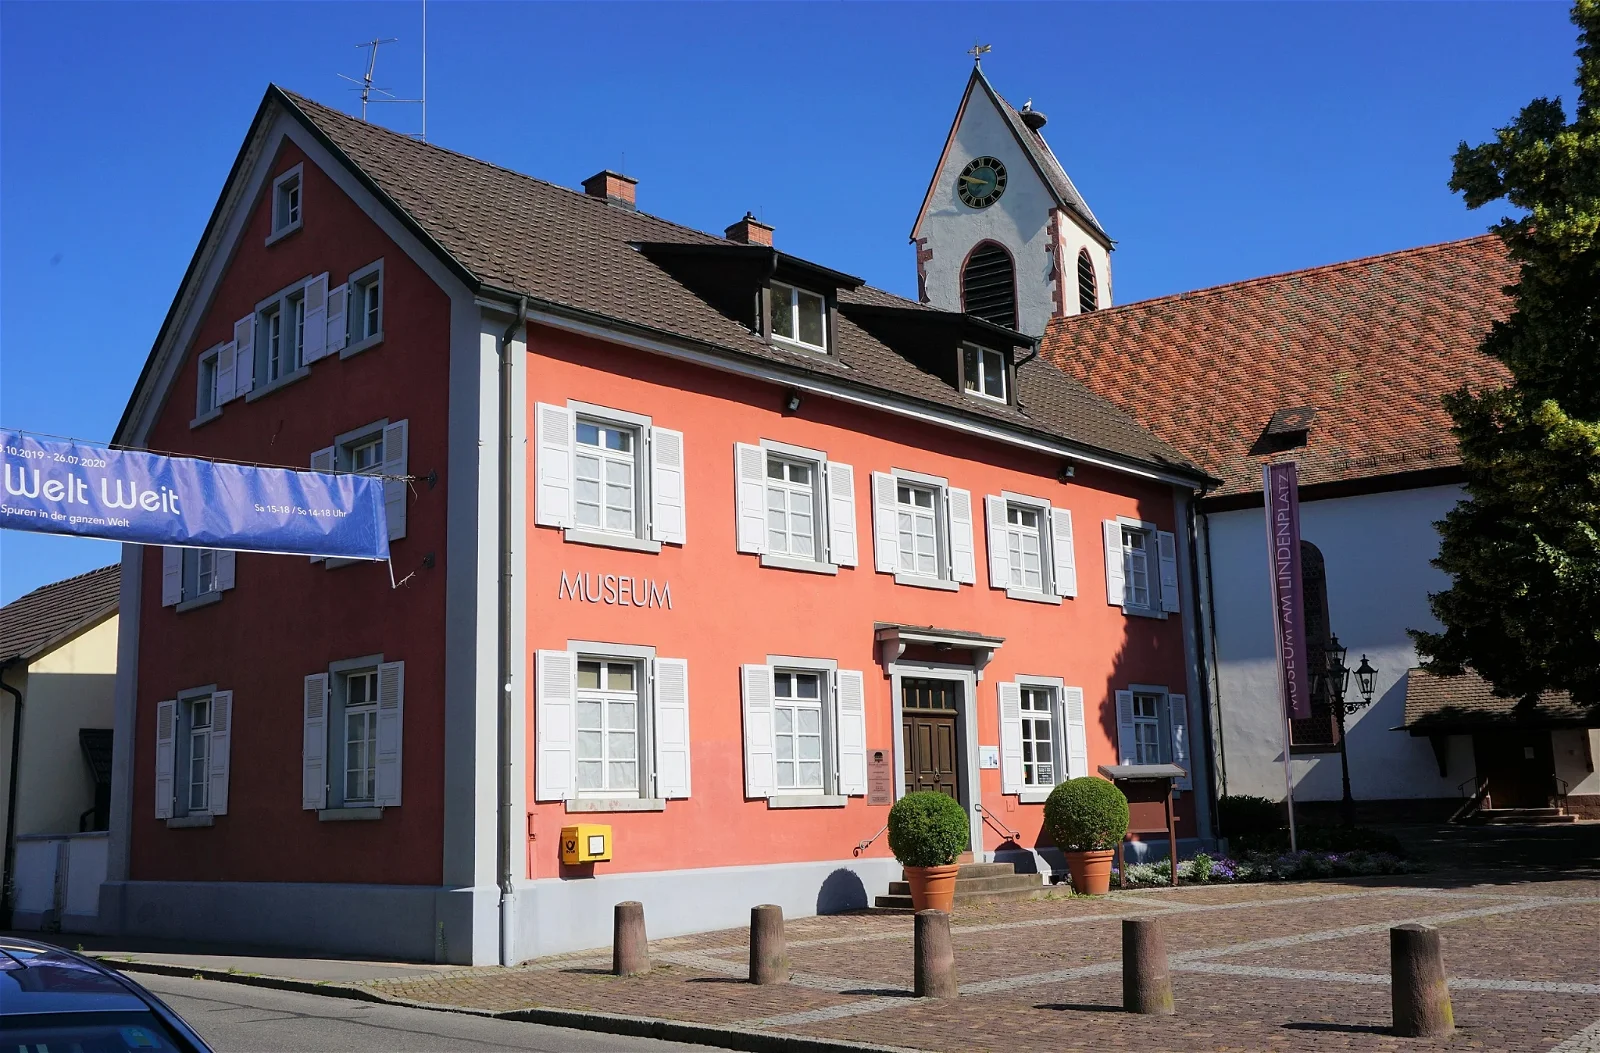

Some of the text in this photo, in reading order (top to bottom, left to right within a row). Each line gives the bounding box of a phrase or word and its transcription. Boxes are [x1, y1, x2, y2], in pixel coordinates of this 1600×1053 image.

[53, 452, 106, 468] 26.07.2020
[5, 463, 180, 515] Welt Weit
[1, 504, 130, 528] Spuren in der ganzen Welt
[254, 503, 265, 512] Sa
[267, 505, 290, 514] 15-18
[297, 507, 307, 516] So
[308, 509, 331, 517] 14-18
[333, 509, 346, 518] Uhr
[1276, 474, 1292, 589] LINDENPLATZ
[559, 570, 673, 609] MUSEUM
[1280, 595, 1293, 624] AM
